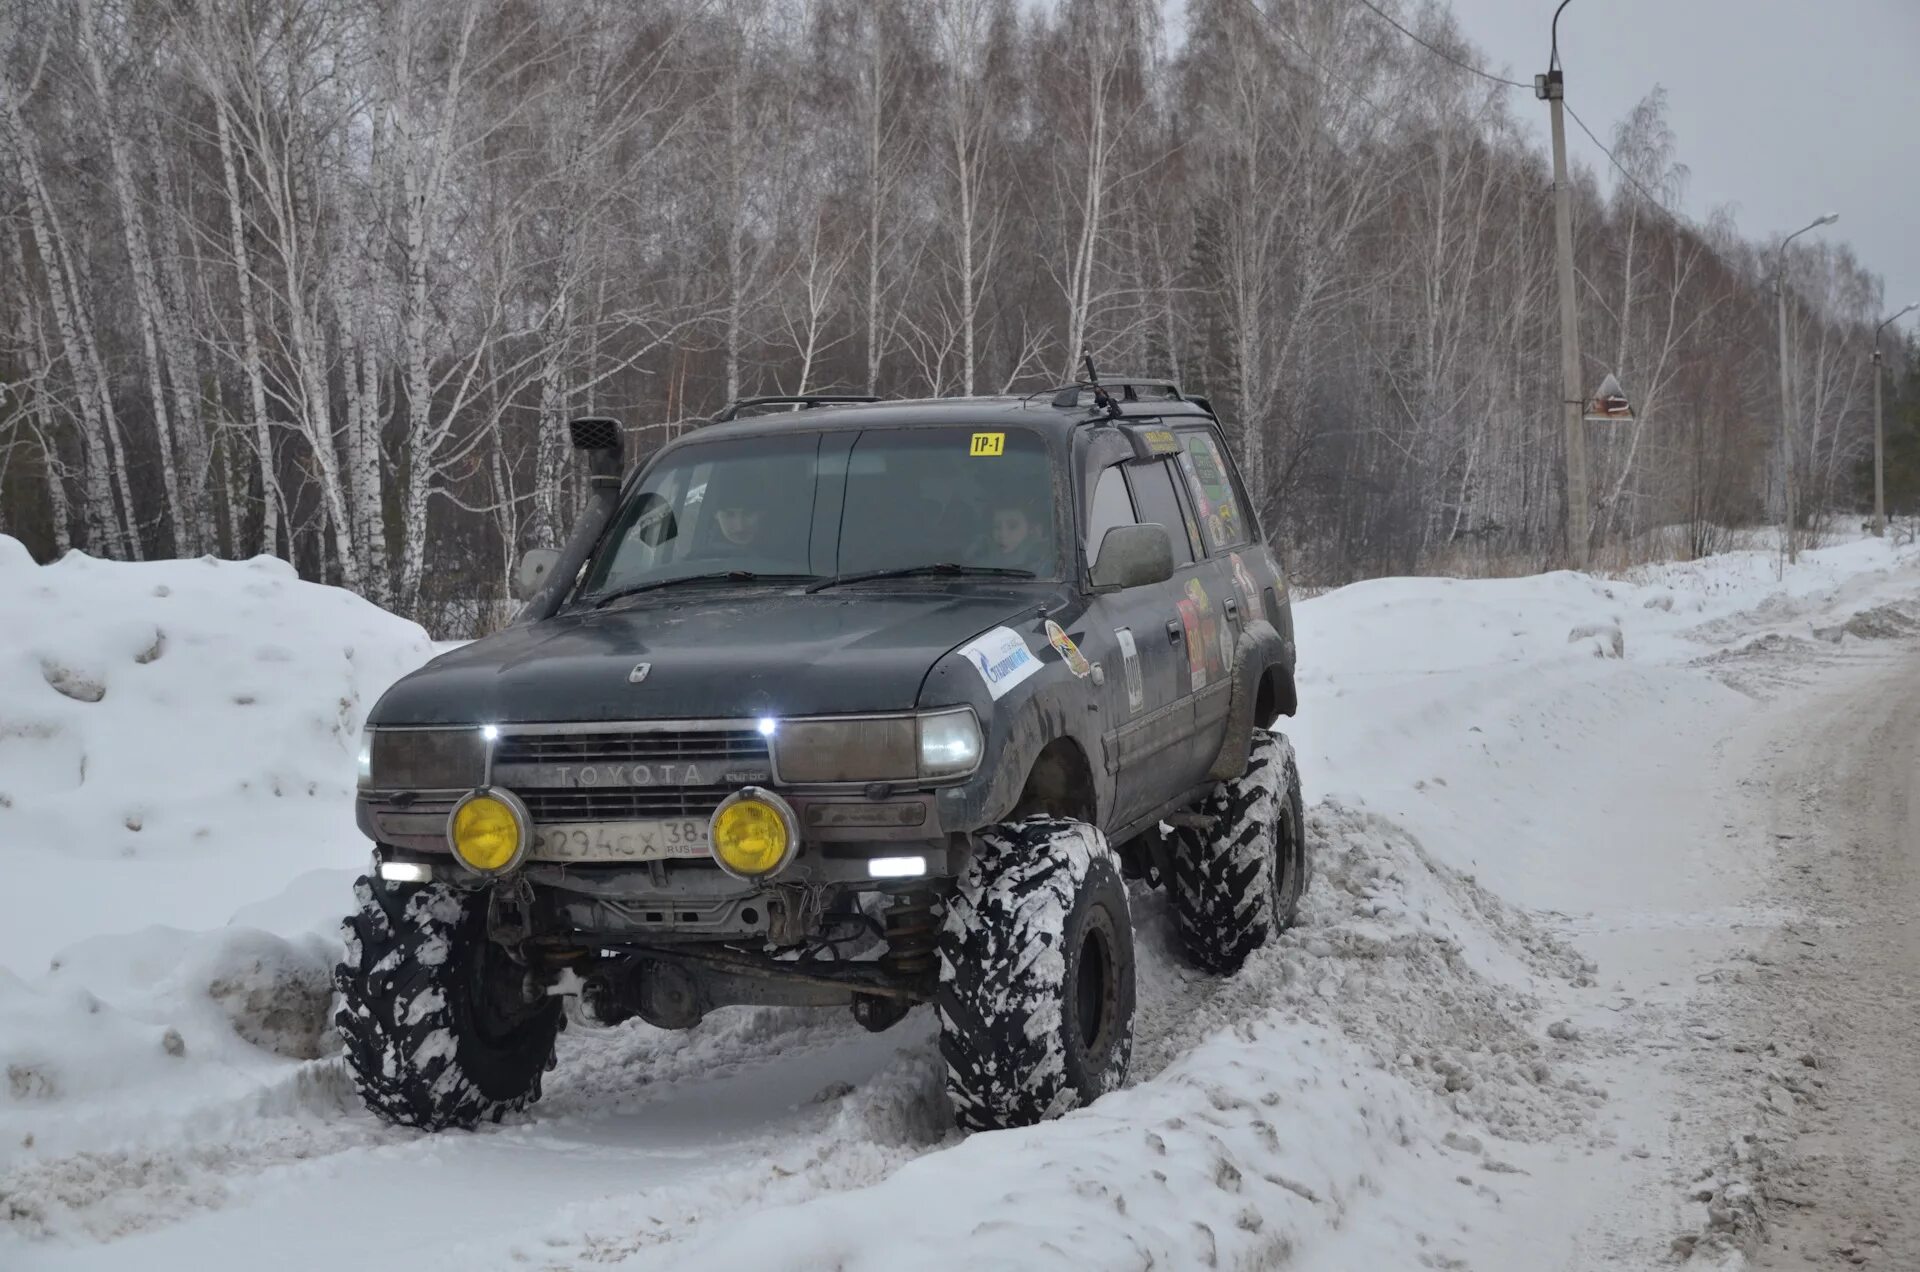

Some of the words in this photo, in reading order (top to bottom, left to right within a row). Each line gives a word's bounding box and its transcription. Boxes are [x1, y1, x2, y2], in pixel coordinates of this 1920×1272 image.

[556, 765, 702, 786] TOYOTA
[665, 823, 697, 844] 38
[667, 845, 690, 854] RUS
